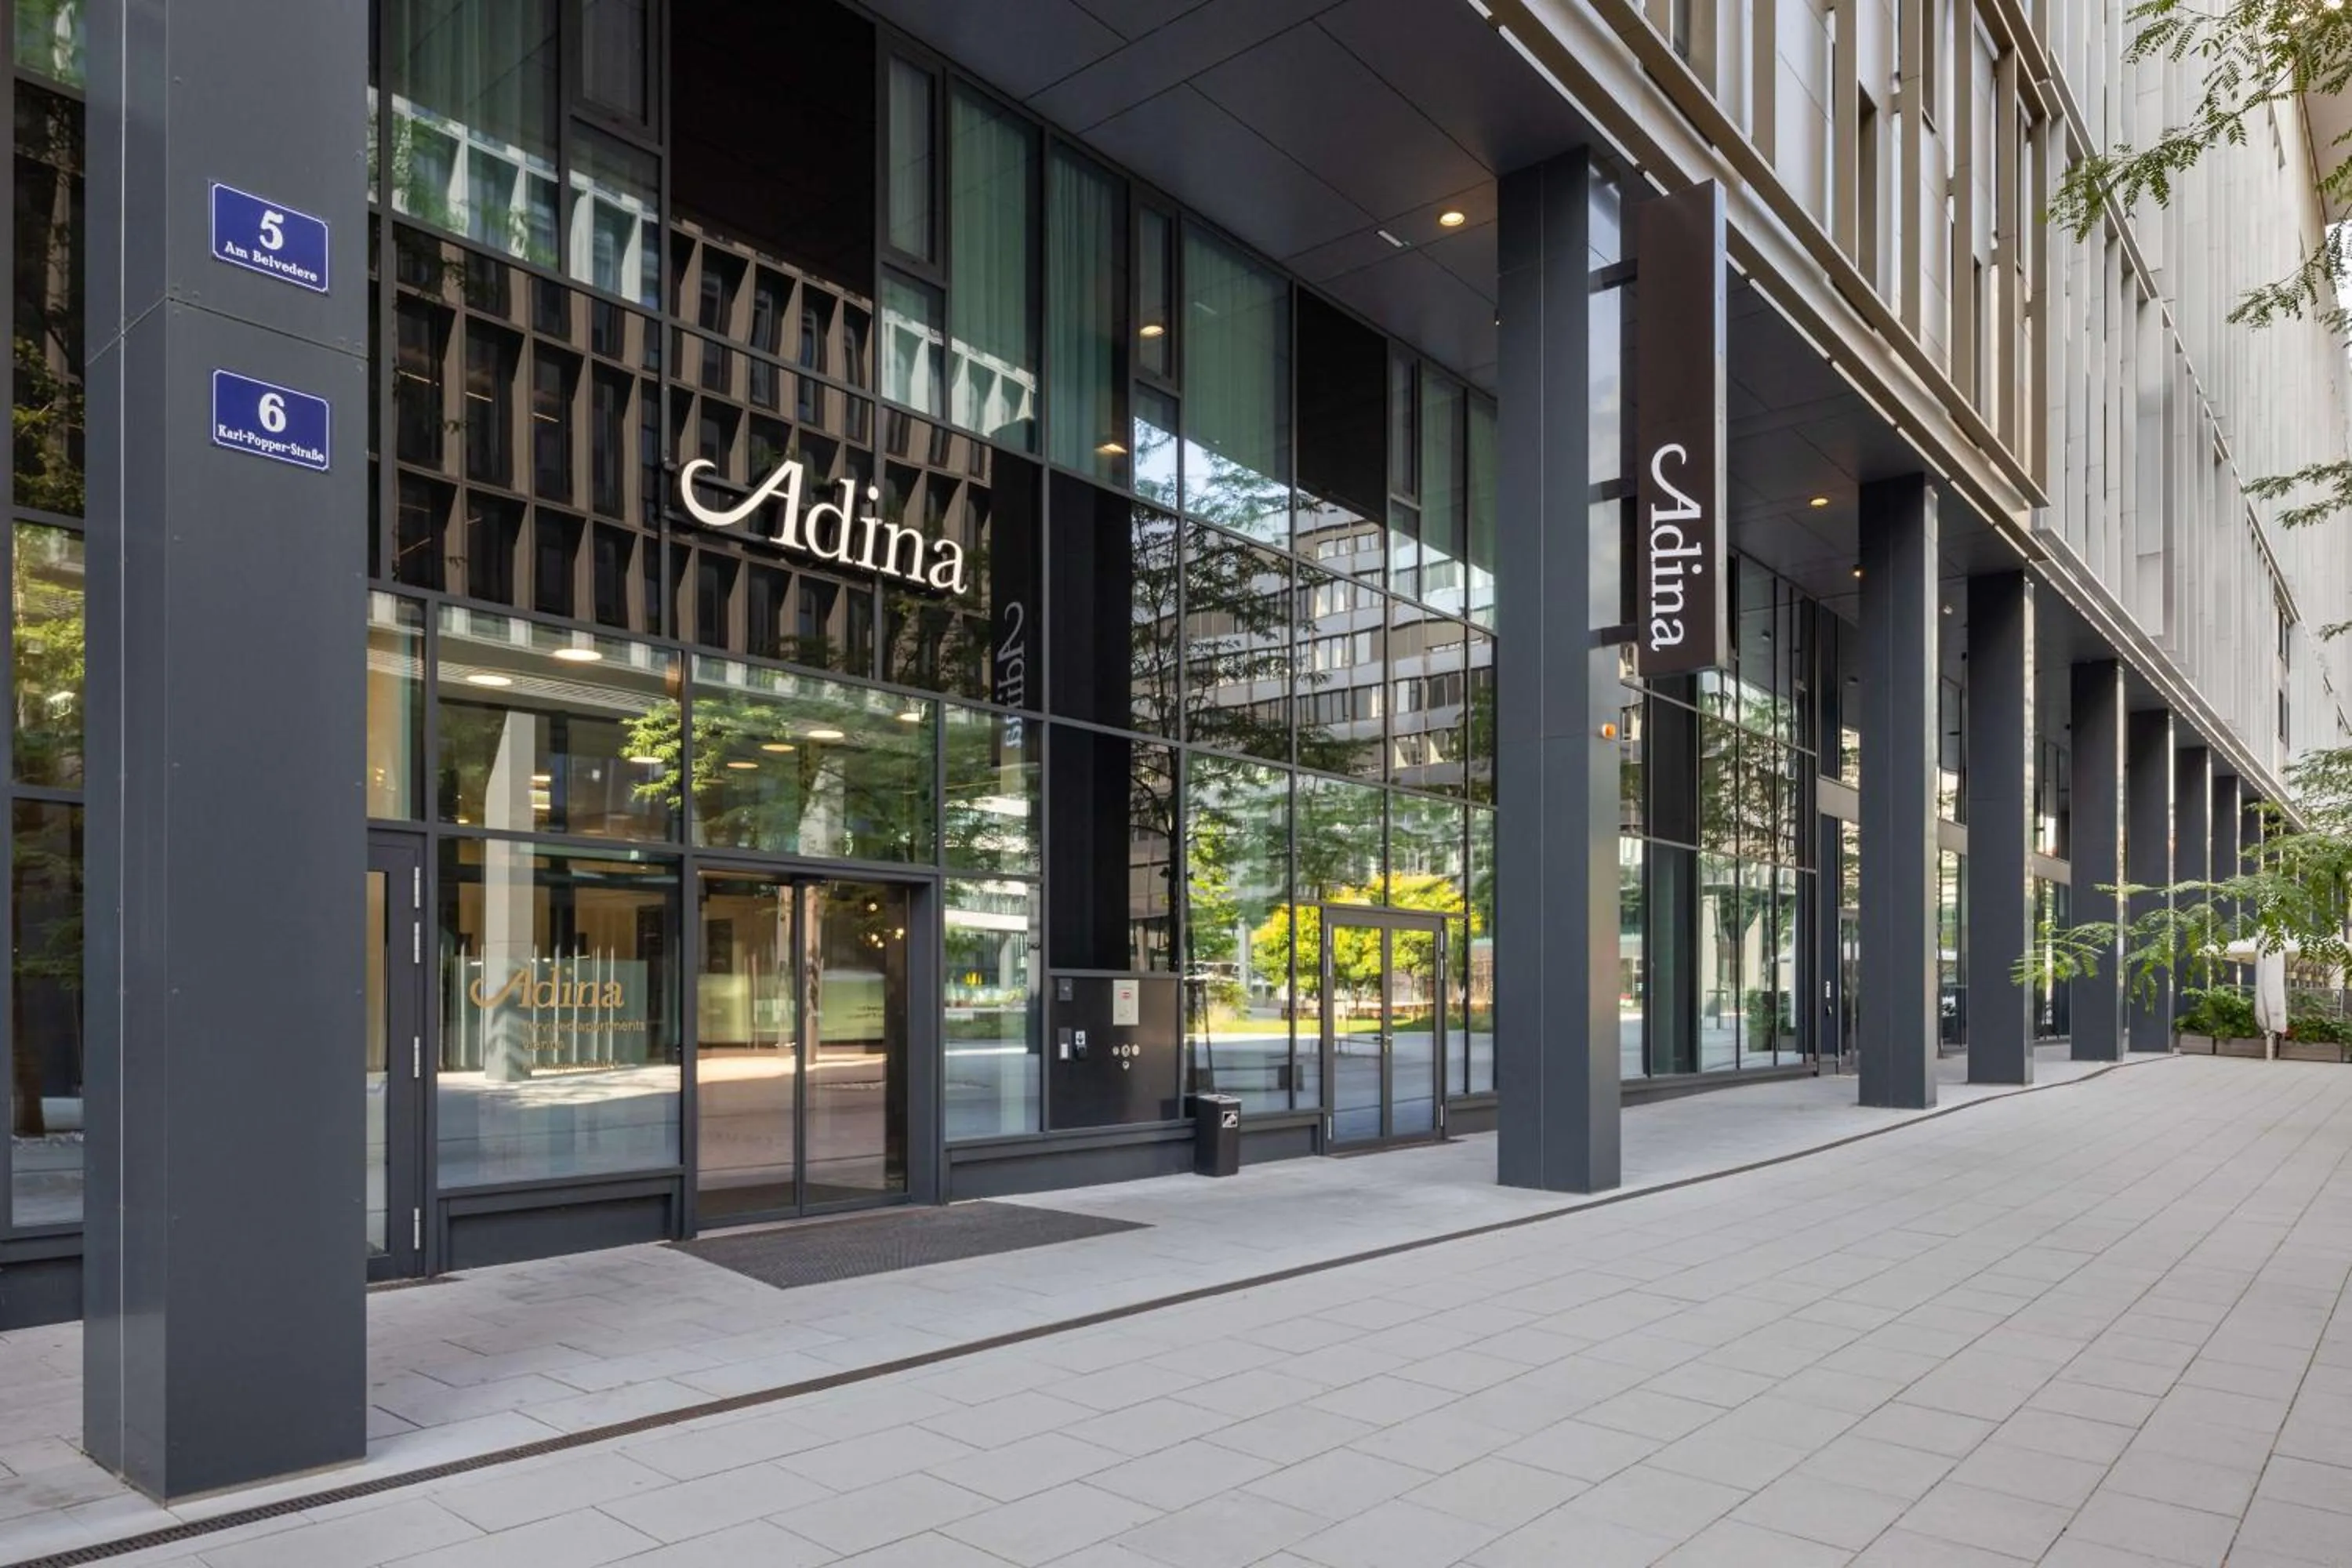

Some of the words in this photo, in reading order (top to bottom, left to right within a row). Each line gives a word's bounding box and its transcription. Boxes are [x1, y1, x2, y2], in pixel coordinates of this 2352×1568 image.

[259, 209, 285, 251] 5
[224, 241, 249, 260] Am
[252, 249, 318, 283] Belvedere
[258, 392, 287, 434] 6
[217, 424, 325, 463] Karl-Popper-Straße
[681, 458, 967, 595] Adina
[1650, 443, 1702, 652] Adina
[470, 966, 625, 1009] Adina
